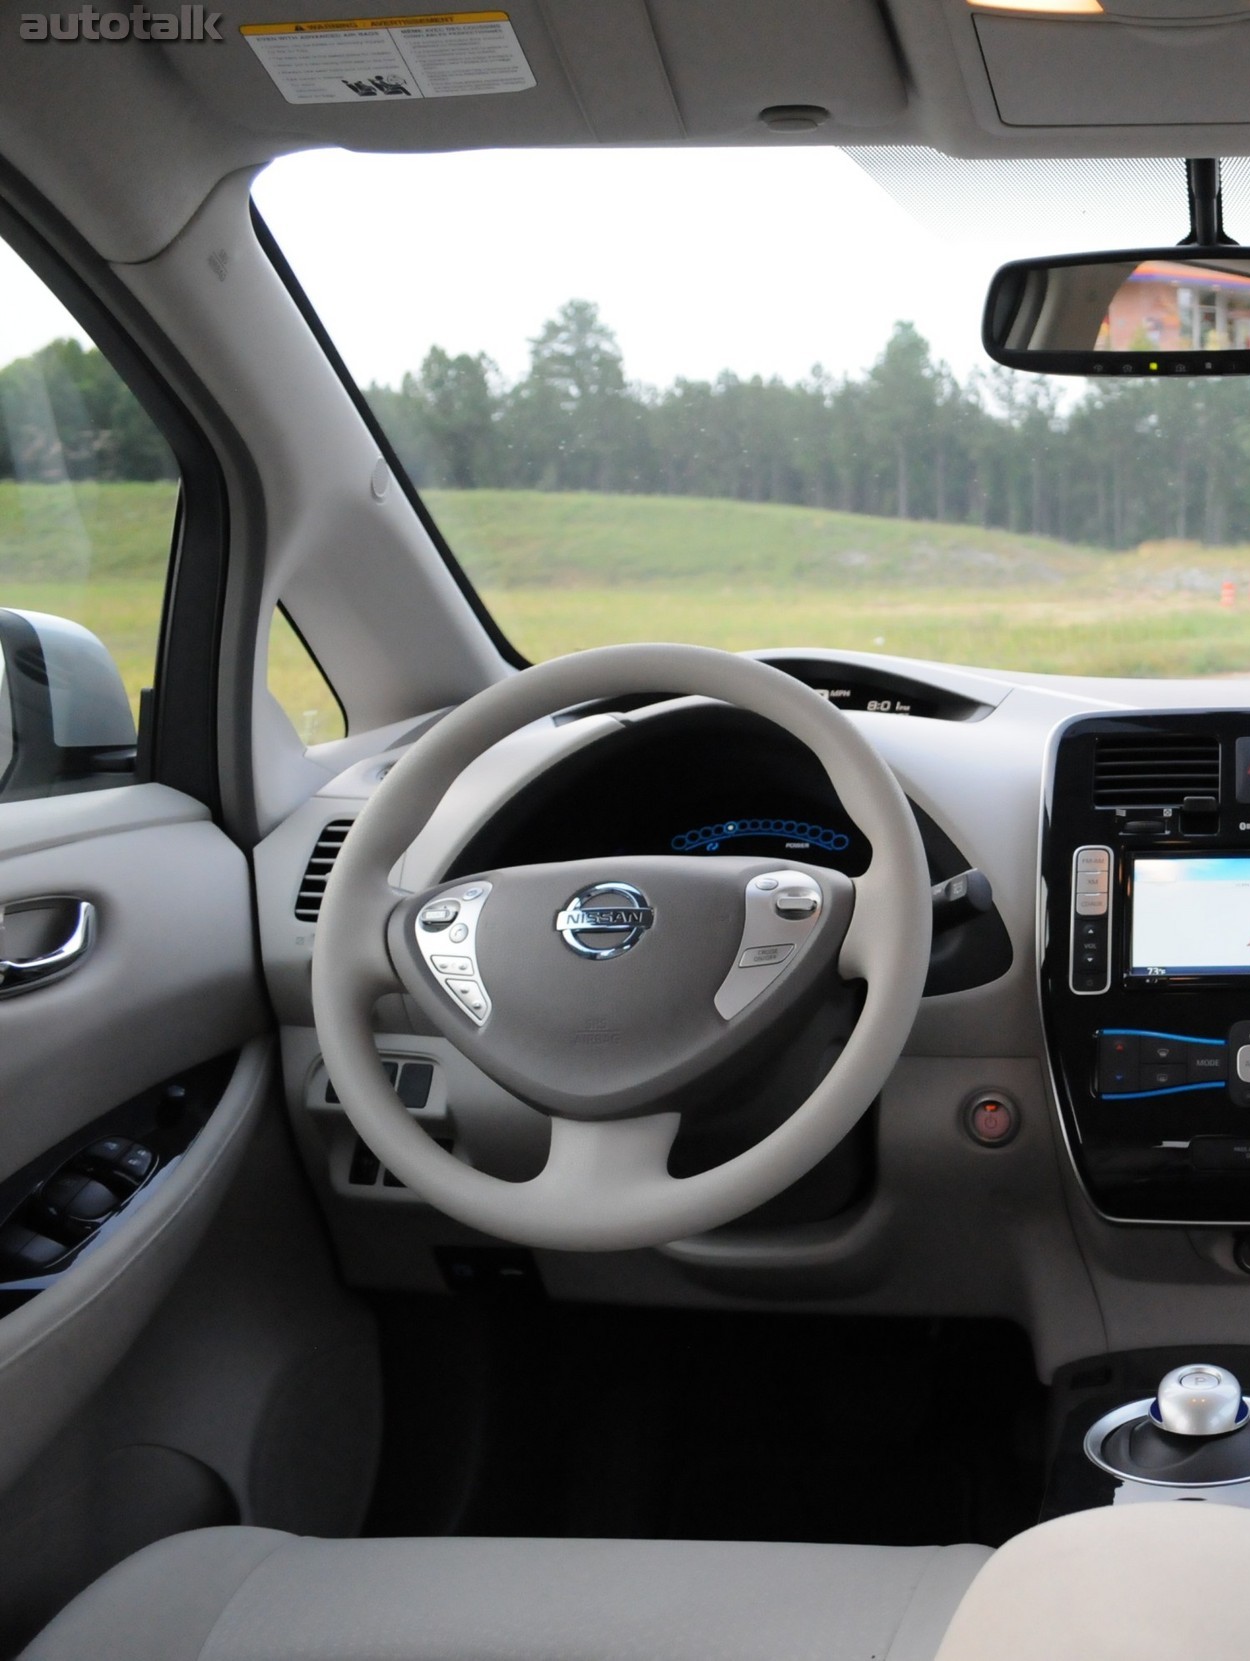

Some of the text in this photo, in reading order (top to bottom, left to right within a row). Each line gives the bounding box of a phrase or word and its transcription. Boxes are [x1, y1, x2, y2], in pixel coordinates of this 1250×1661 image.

[830, 689, 851, 697] MPH
[566, 911, 643, 925] NISSAN
[1195, 1377, 1206, 1386] P
